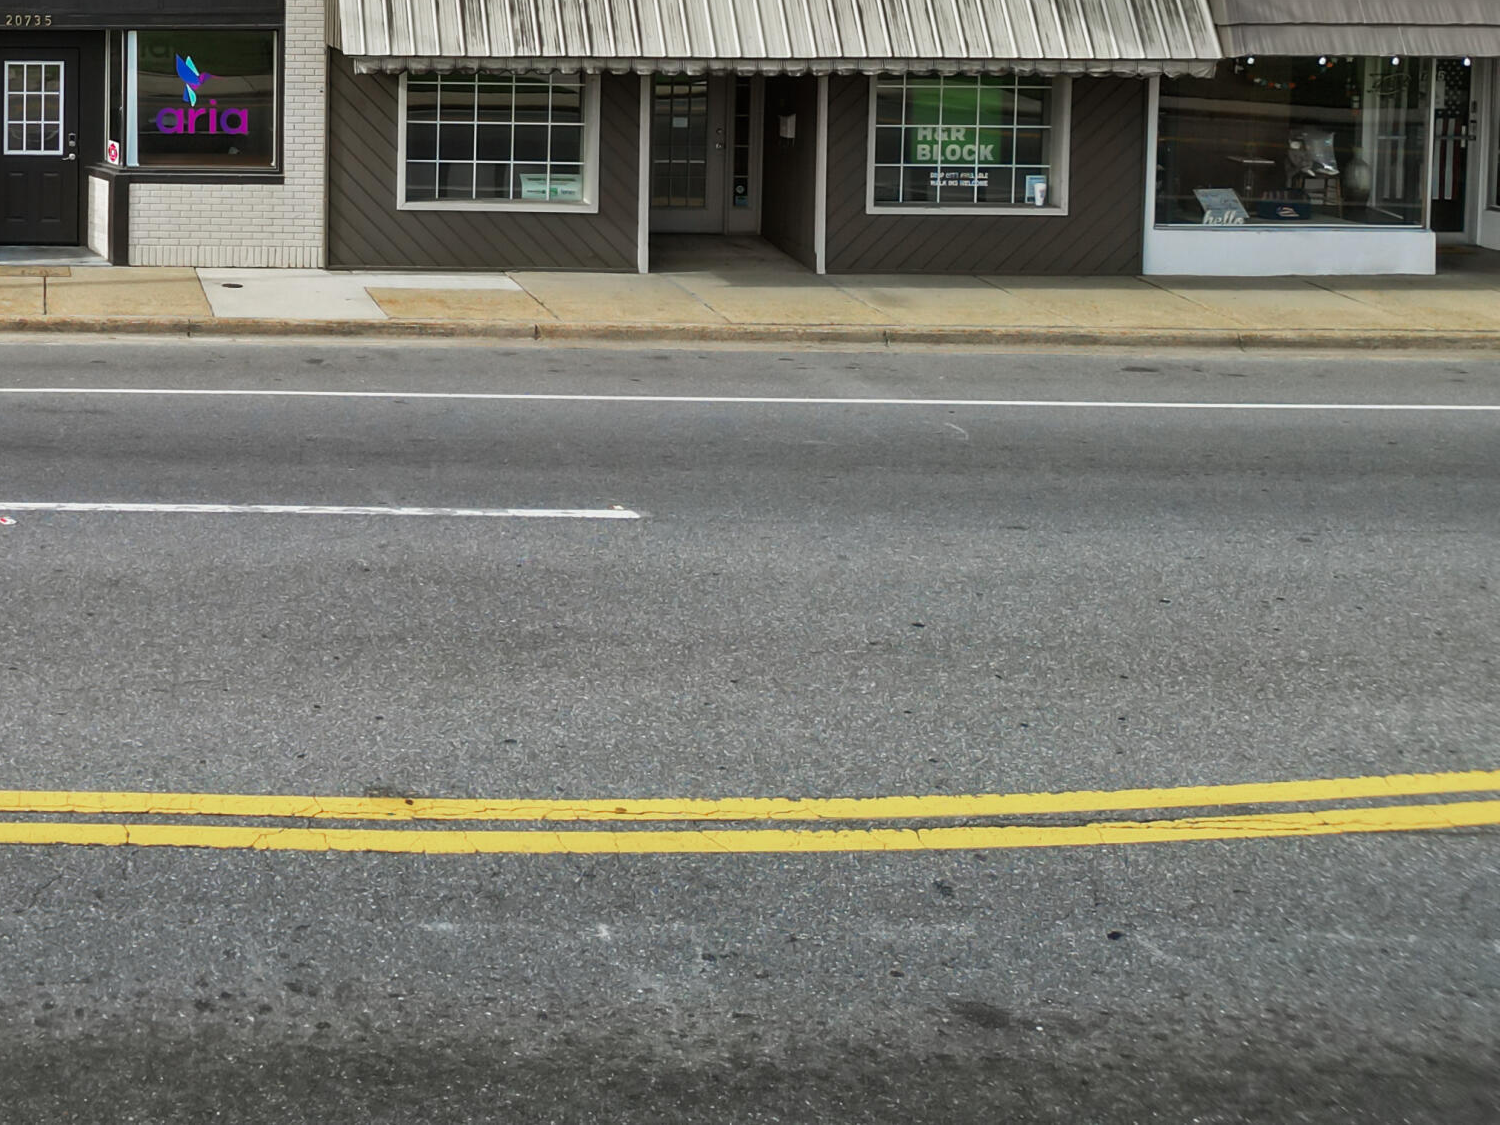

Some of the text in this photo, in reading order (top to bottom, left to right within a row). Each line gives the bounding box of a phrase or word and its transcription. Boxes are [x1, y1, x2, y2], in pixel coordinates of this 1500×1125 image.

[5, 14, 52, 26] 20735
[156, 99, 249, 135] aria
[917, 126, 966, 141] H&R
[916, 144, 994, 161] BLOCK
[1203, 210, 1244, 225] hello
